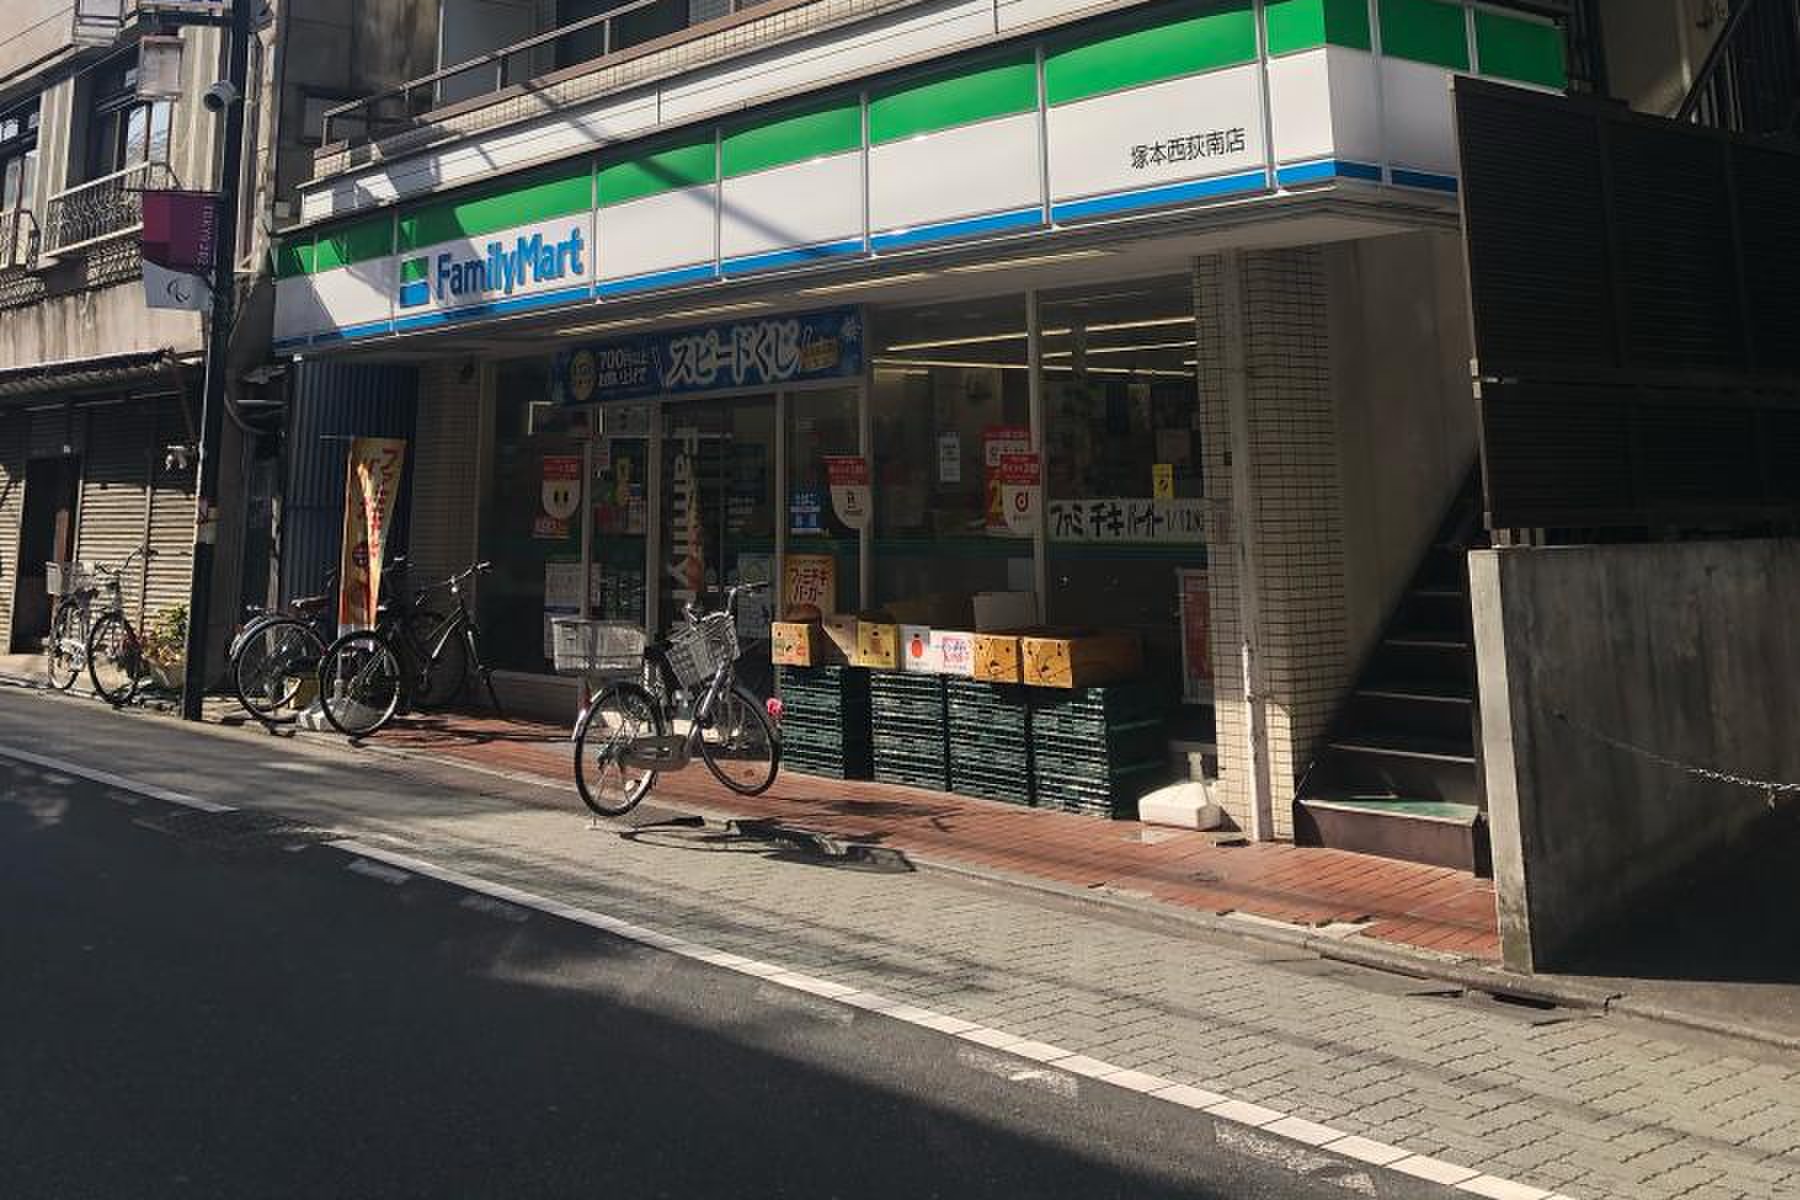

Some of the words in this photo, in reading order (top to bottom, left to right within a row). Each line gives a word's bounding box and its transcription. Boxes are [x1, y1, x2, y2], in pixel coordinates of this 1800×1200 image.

[1131, 128, 1245, 169] 塚本西荻南店
[436, 226, 583, 301] FamilyMart
[668, 318, 801, 387] スピードくじ
